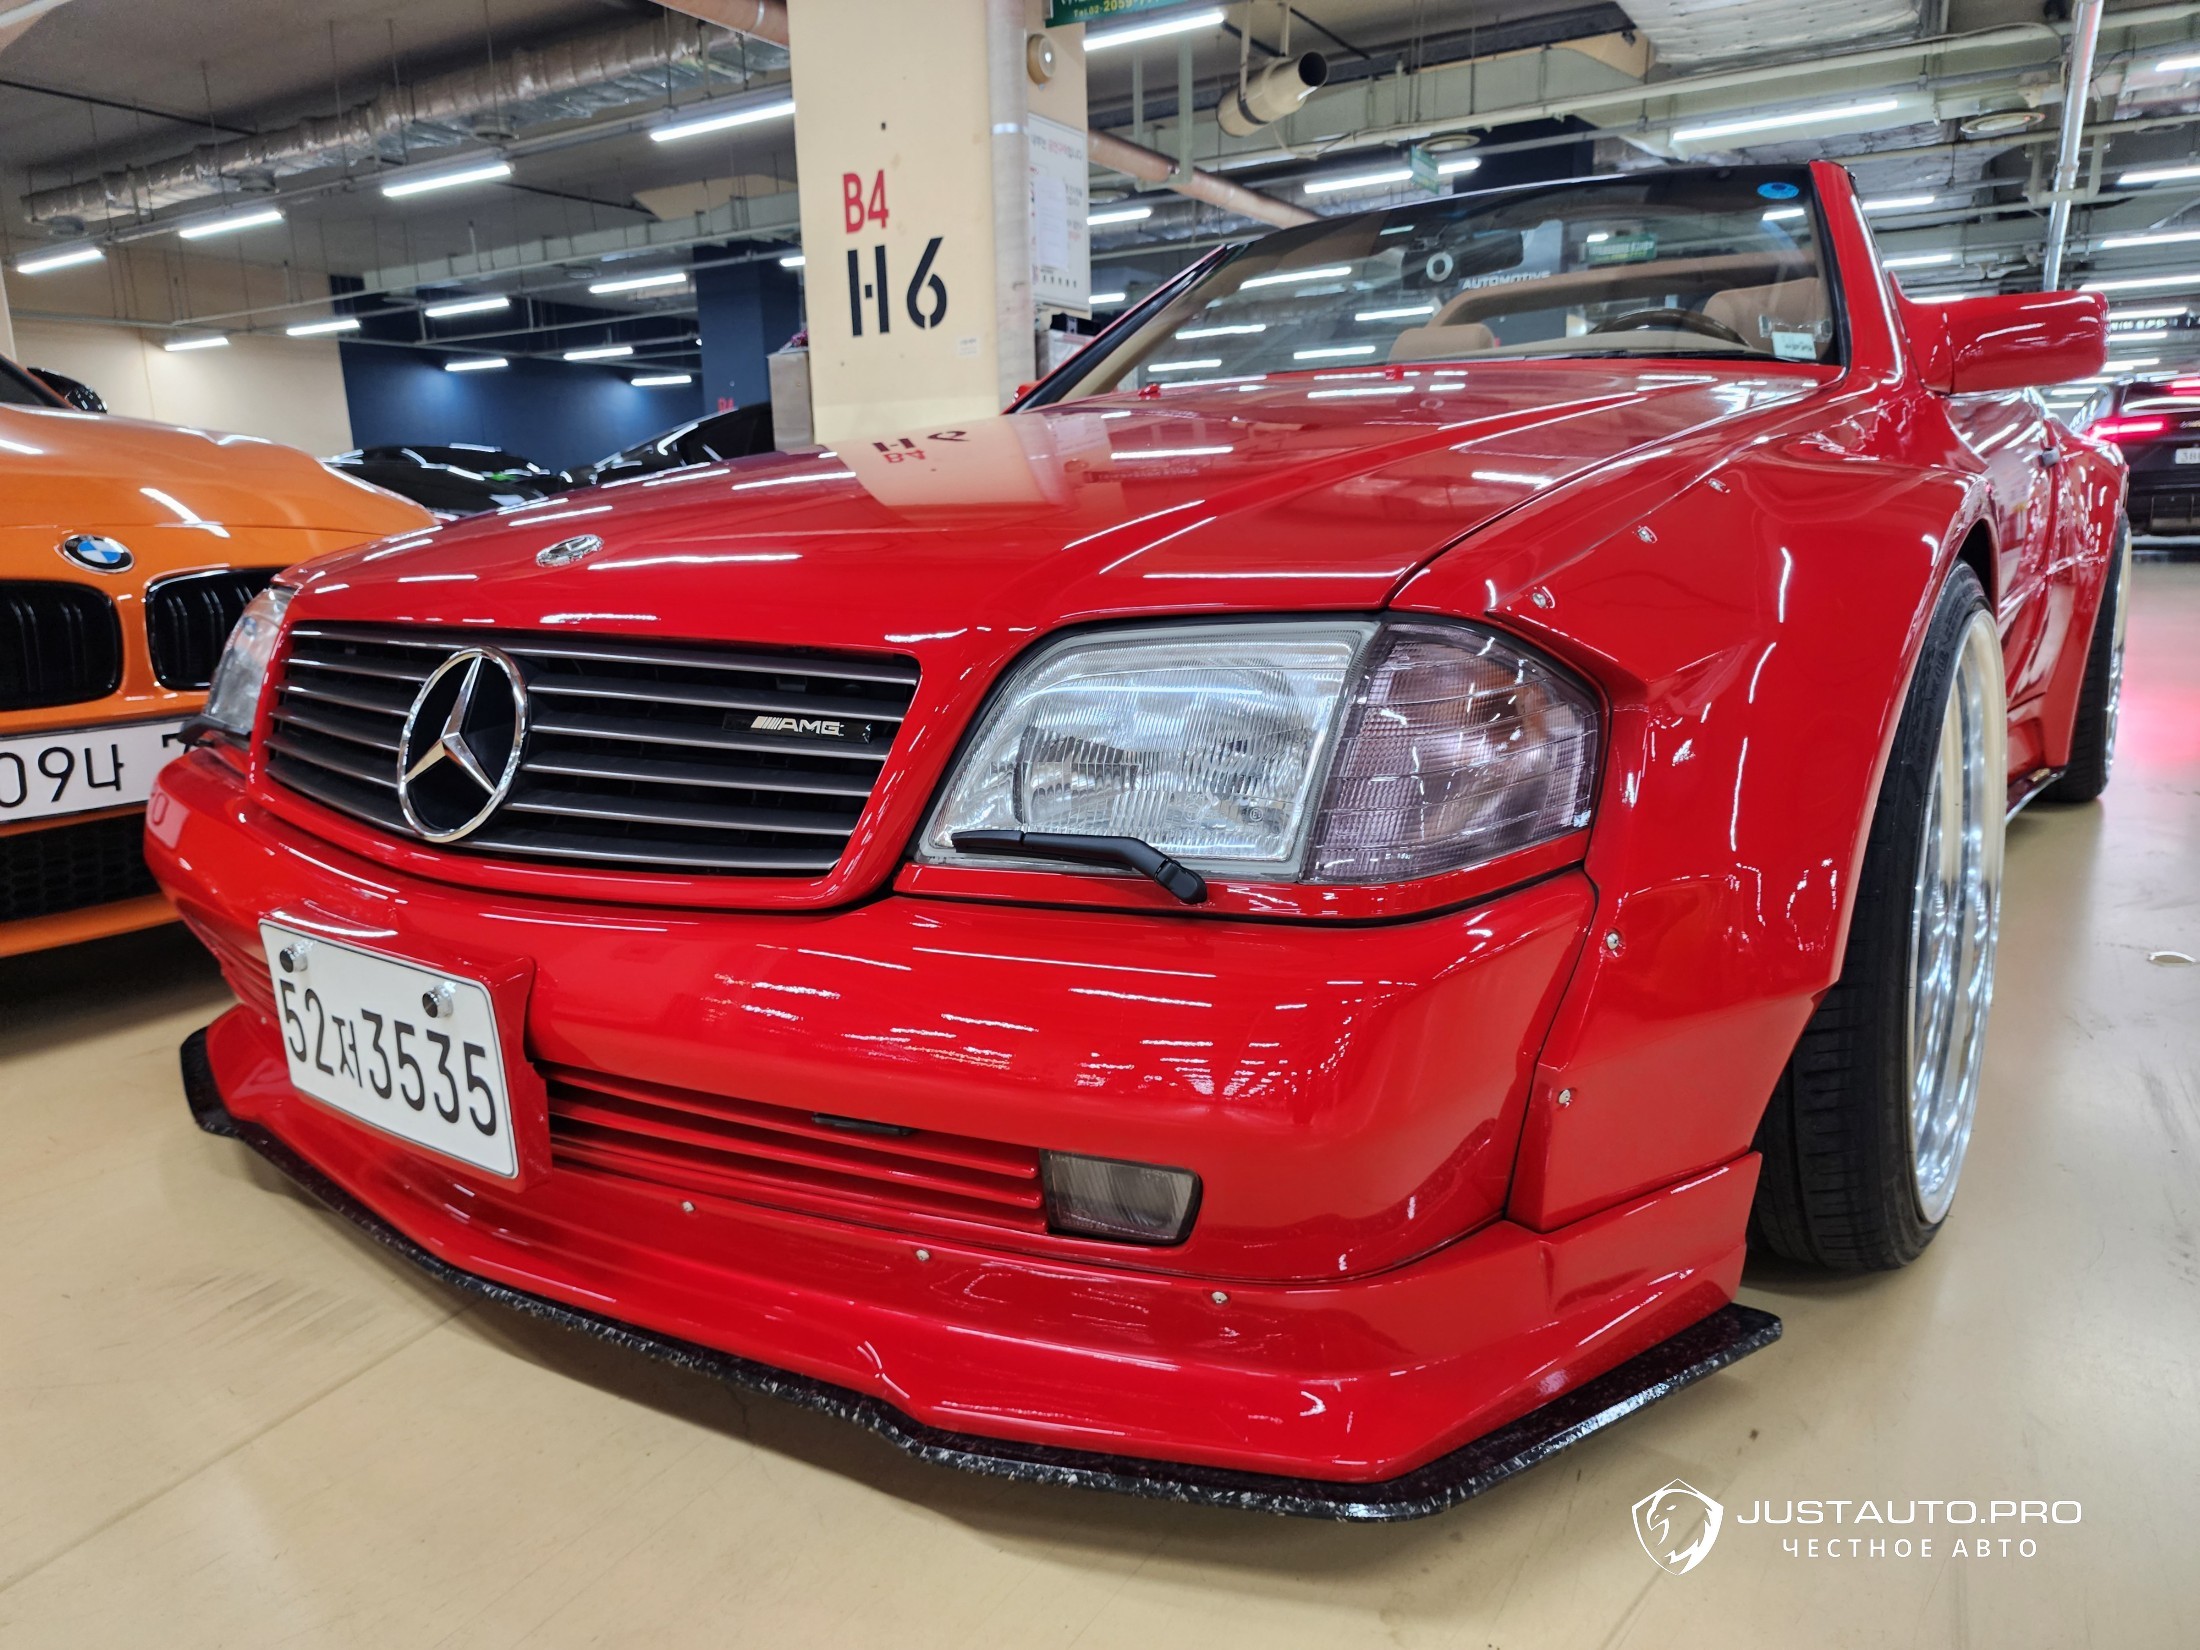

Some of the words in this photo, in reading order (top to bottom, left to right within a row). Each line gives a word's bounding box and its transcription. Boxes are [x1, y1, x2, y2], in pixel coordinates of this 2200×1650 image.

[842, 168, 889, 235] B4
[847, 236, 947, 337] H6
[779, 718, 842, 735] AMG
[280, 979, 498, 1137] 52저3535
